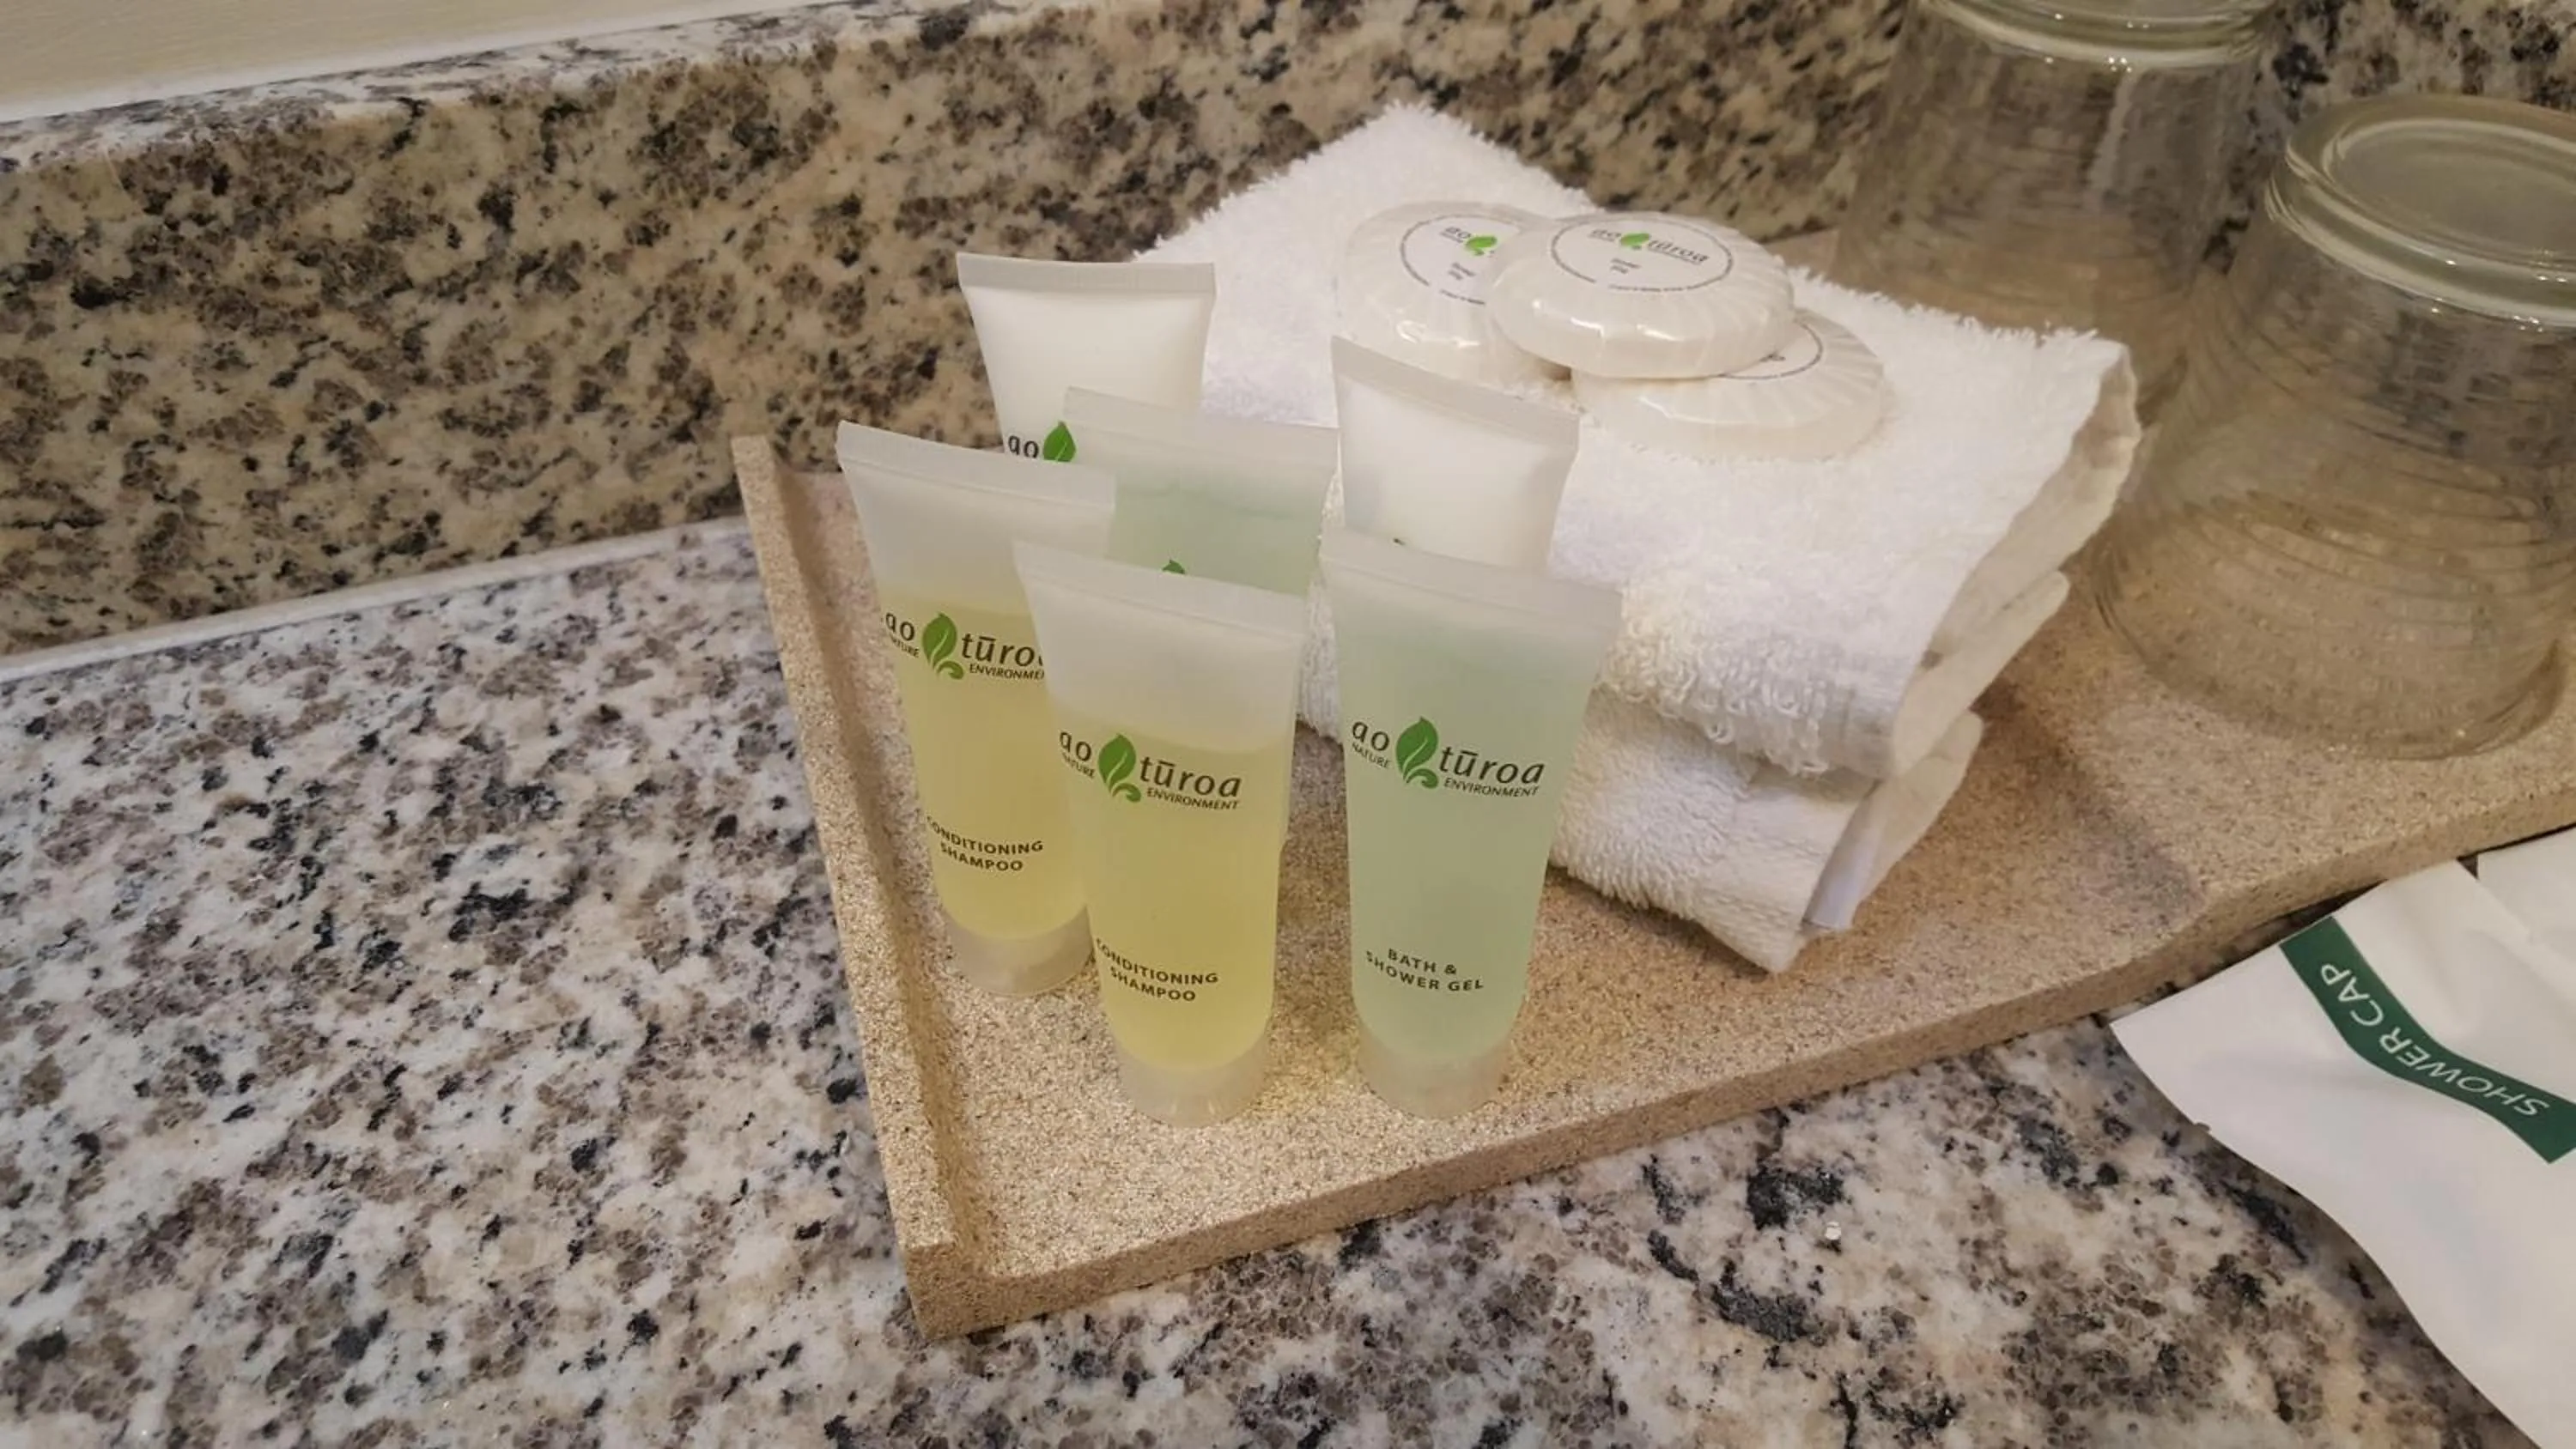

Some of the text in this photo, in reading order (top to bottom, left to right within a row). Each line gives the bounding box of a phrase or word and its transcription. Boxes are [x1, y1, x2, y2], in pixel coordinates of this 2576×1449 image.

[1008, 434, 1040, 459] ao
[885, 612, 1043, 667] ao tūro
[969, 663, 1045, 680] ENVIRONME
[1059, 731, 1242, 797] ao tūroa
[1352, 721, 1545, 785] ao tūroa
[1352, 742, 1539, 797] NATURE ENVIRONMENT
[1146, 787, 1239, 810] ENVIRONMENT
[940, 840, 1024, 871] SHAMPOO
[1365, 950, 1484, 991] SHOWER GEL
[1388, 948, 1457, 975] BATH &
[1110, 965, 1196, 1002] SHAMPOO
[2320, 962, 2550, 1117] SHOWER CAP
